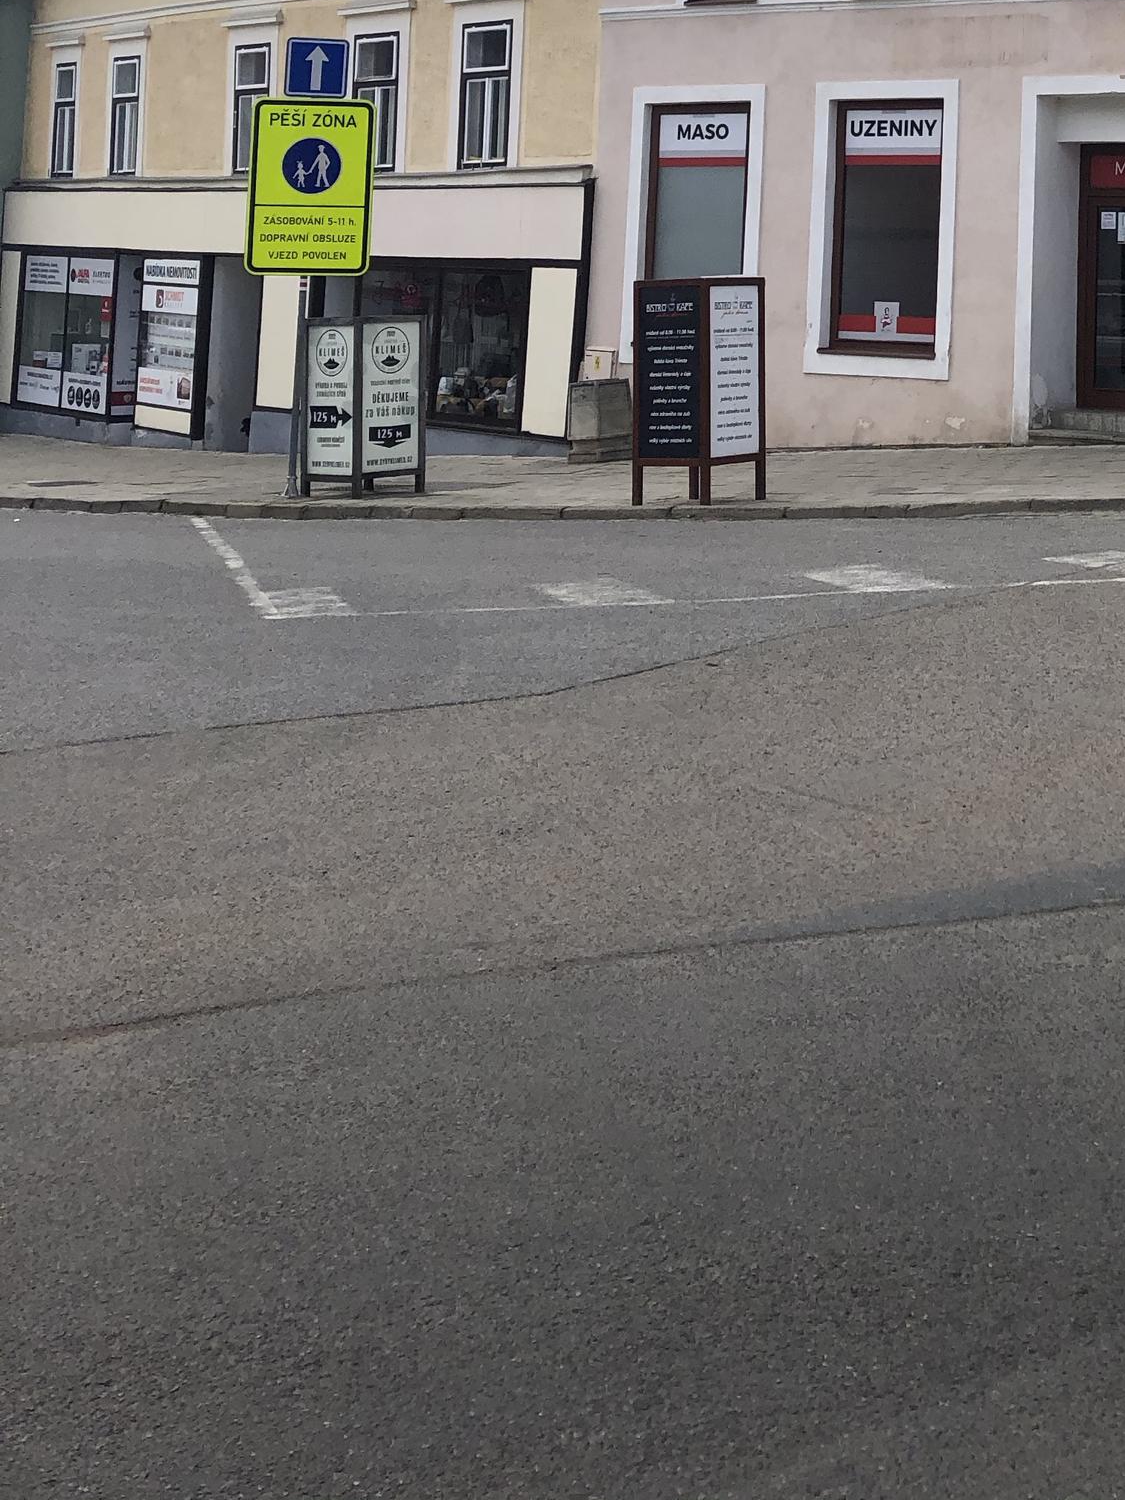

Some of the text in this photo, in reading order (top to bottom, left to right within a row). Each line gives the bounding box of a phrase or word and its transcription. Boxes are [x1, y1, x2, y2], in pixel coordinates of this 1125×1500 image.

[269, 109, 357, 128] PĚŠÍ ZÓNA
[677, 123, 729, 140] MASO
[850, 119, 937, 137] UZENINY
[263, 215, 357, 227] ZÁSOBOVÁNÍ 5-11 h.
[259, 232, 356, 244] DOPRAVNÍ OBSLUZE
[268, 251, 347, 261] VJEZD POVOLEN
[319, 346, 345, 357] KLIMEŠ
[375, 342, 407, 354] KLIMEŠ
[372, 391, 409, 404] DĚKUJEME
[313, 411, 328, 423] 125
[365, 405, 415, 418] za Váš nákup
[377, 428, 393, 439] 125
